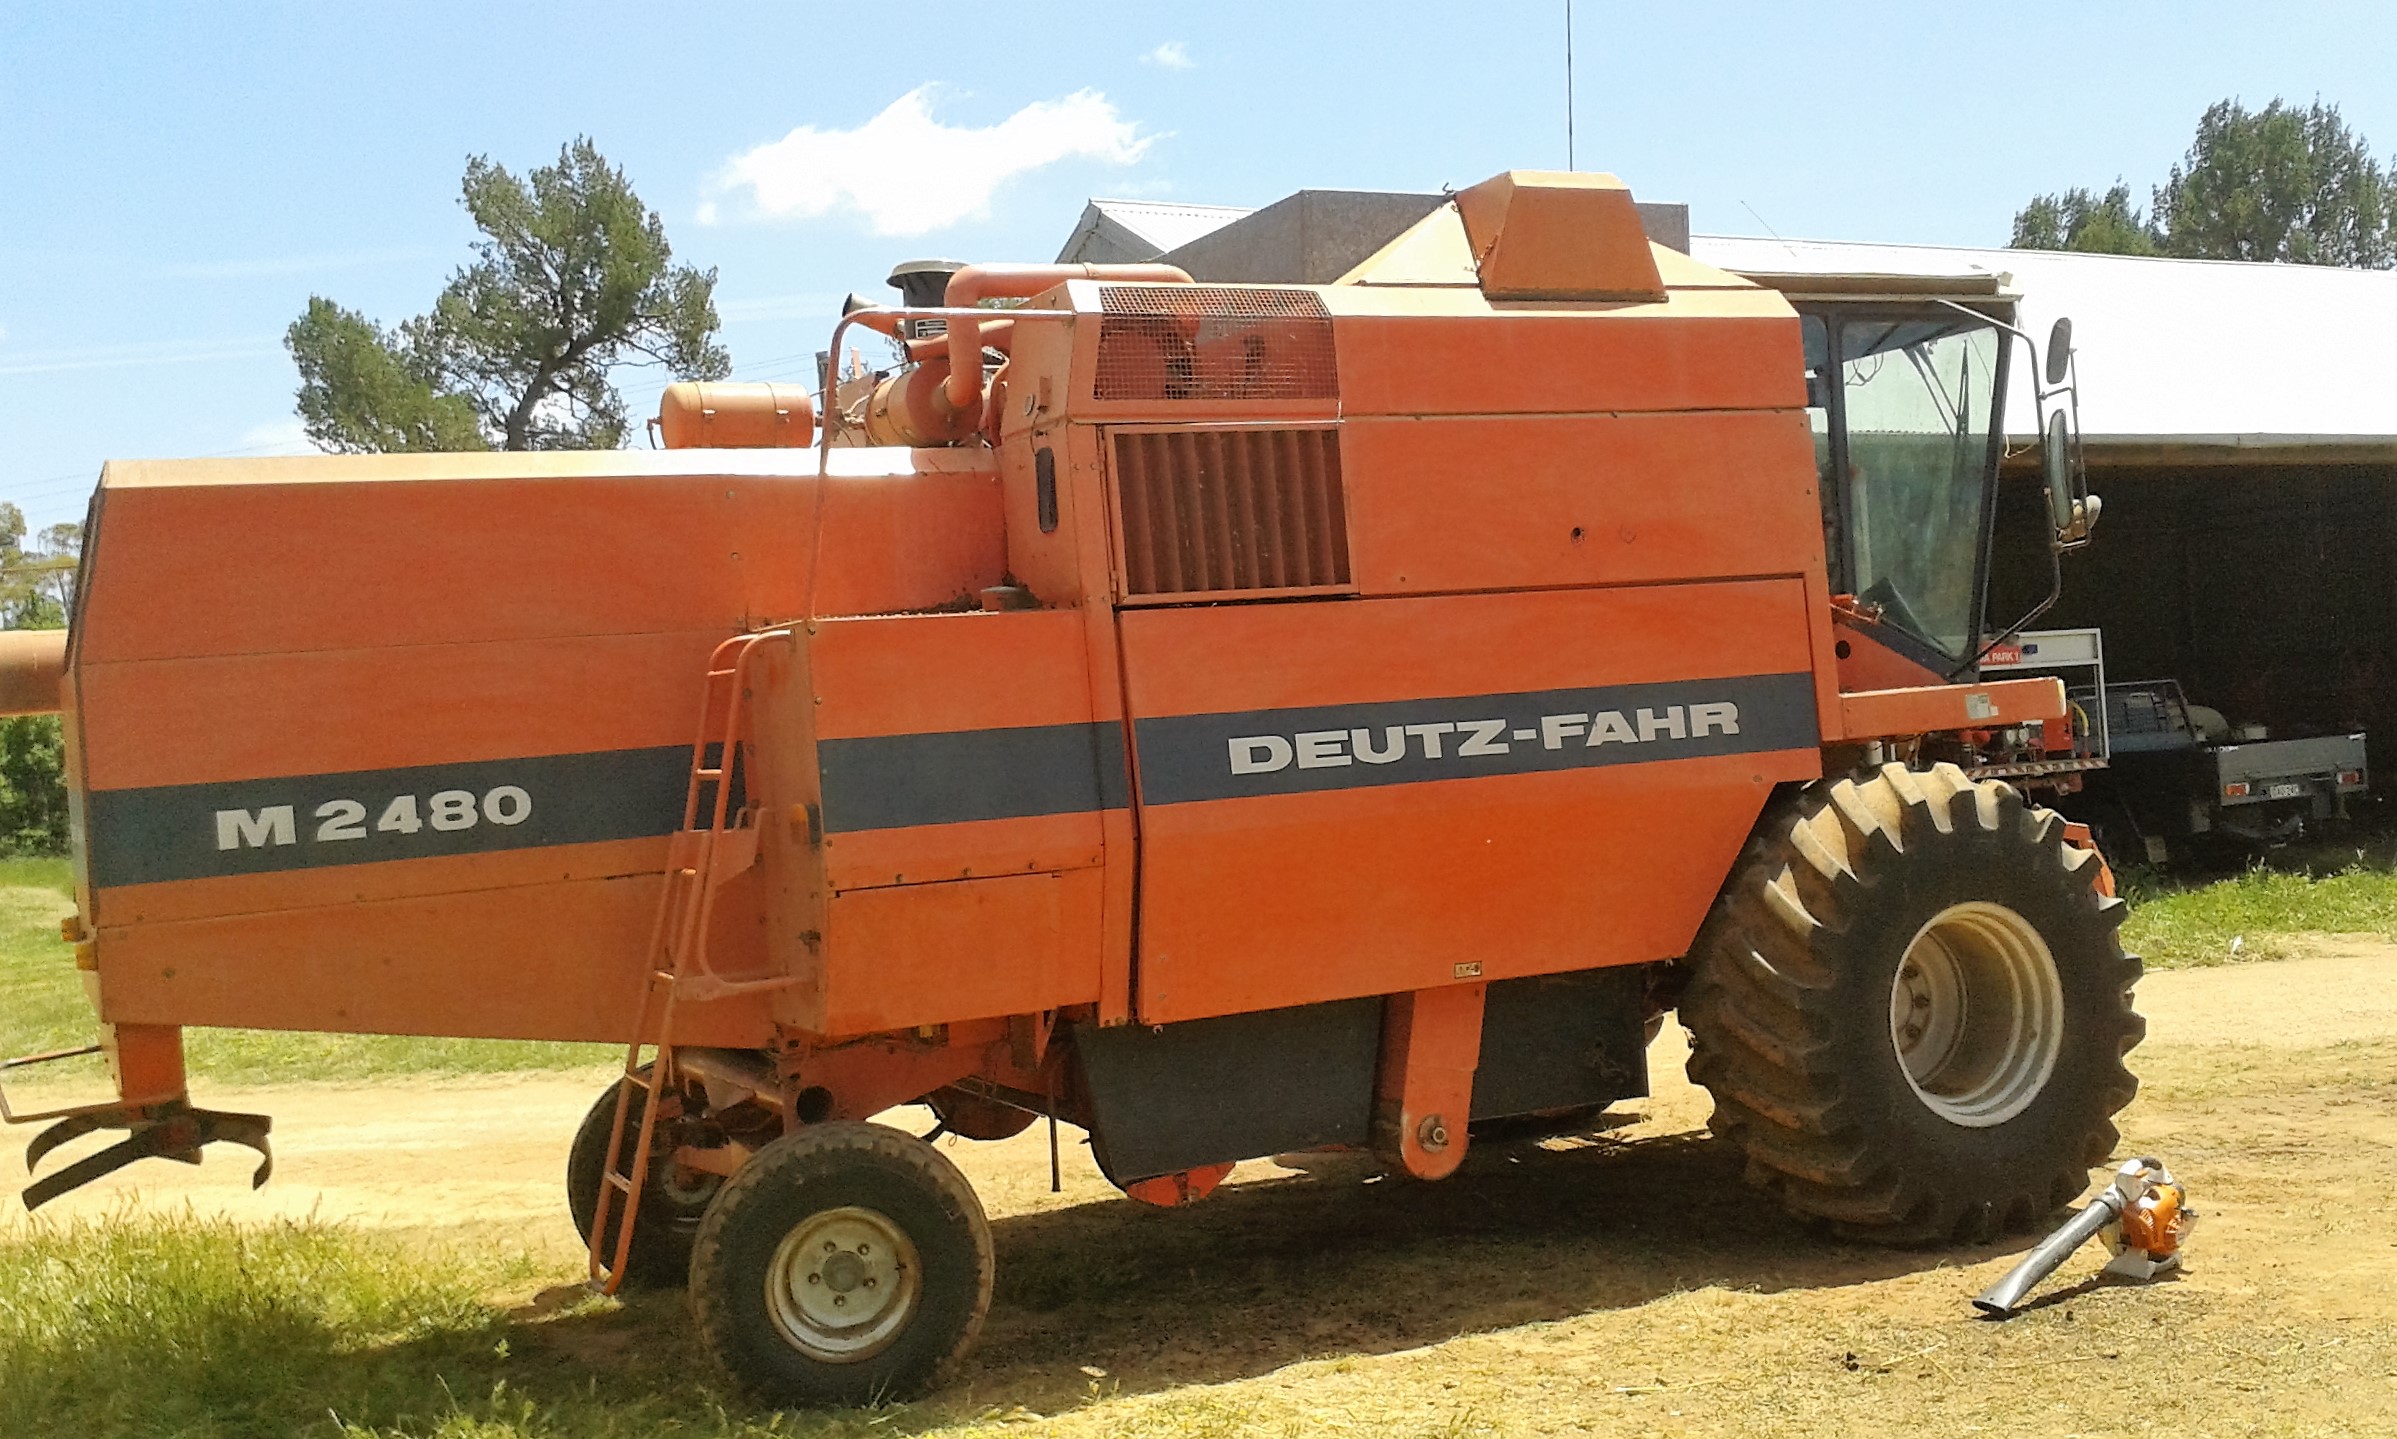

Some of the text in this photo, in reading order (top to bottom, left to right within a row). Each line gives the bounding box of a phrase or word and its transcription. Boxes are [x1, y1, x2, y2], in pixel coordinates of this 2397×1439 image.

[1228, 702, 1740, 775] DEUTZ-FAHR
[216, 785, 532, 850] M 2480
